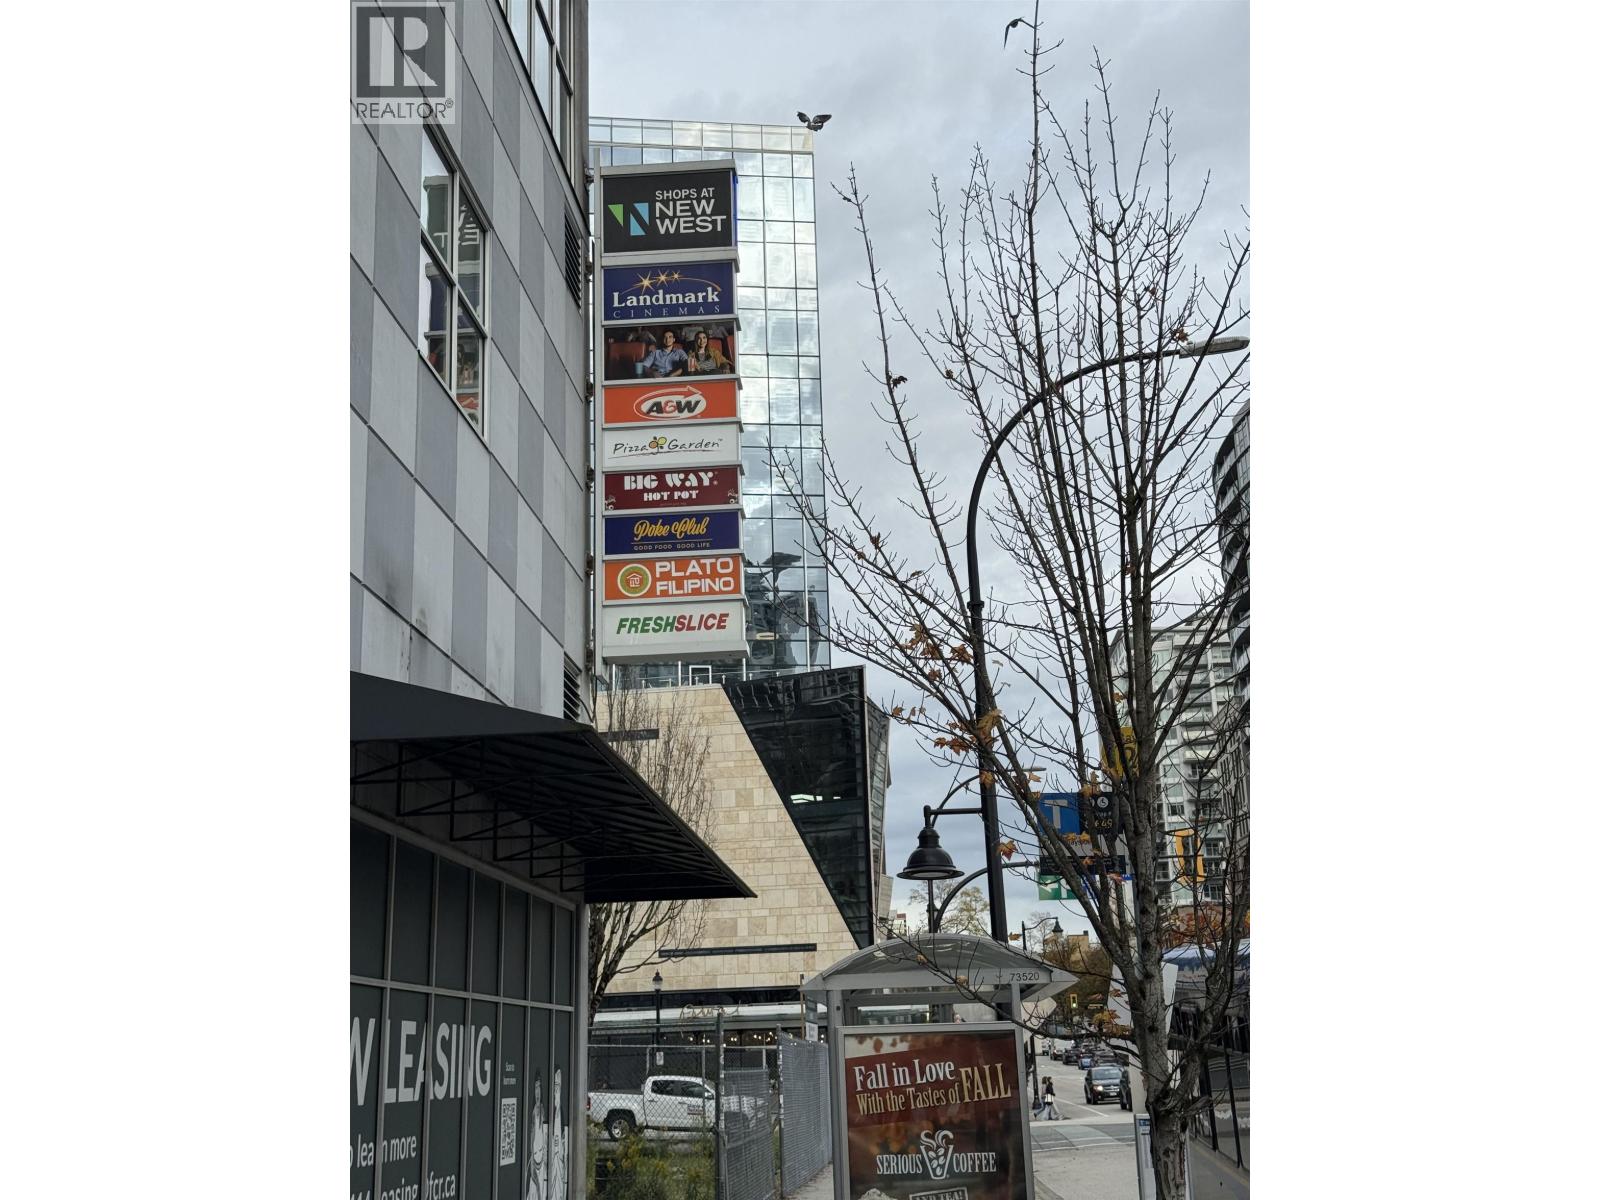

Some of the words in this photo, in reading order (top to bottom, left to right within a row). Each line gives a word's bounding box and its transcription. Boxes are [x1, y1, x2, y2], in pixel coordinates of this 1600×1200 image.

[655, 188, 697, 200] SHOPS
[701, 187, 715, 198] AT
[655, 199, 715, 218] NEW
[655, 215, 727, 235] WEST
[612, 286, 721, 307] Landmark
[613, 305, 720, 319] CINEMAS
[646, 399, 702, 415] A&W
[613, 442, 649, 455] Pizza
[624, 474, 659, 490] BIG
[665, 471, 714, 488] WAY
[643, 491, 671, 502] HOT
[674, 490, 699, 500] POT
[671, 516, 710, 539] Club
[655, 557, 733, 578] PLATO
[656, 577, 735, 596] FILIPINO
[616, 613, 730, 635] FRESHSLICE
[1010, 971, 1040, 982] 73520
[384, 1018, 493, 1104] LEASING
[854, 1062, 888, 1092] Fall
[892, 1062, 911, 1087] in
[913, 1058, 955, 1085] Love
[855, 1091, 885, 1116] With
[887, 1087, 906, 1112] the
[906, 1086, 946, 1111] Tastes
[949, 1082, 961, 1105] of
[959, 1063, 1012, 1104] FALL
[357, 1133, 388, 1169] lean
[390, 1135, 417, 1162] more
[876, 1153, 923, 1175] SERIOUS
[952, 1152, 997, 1173] COFFEE
